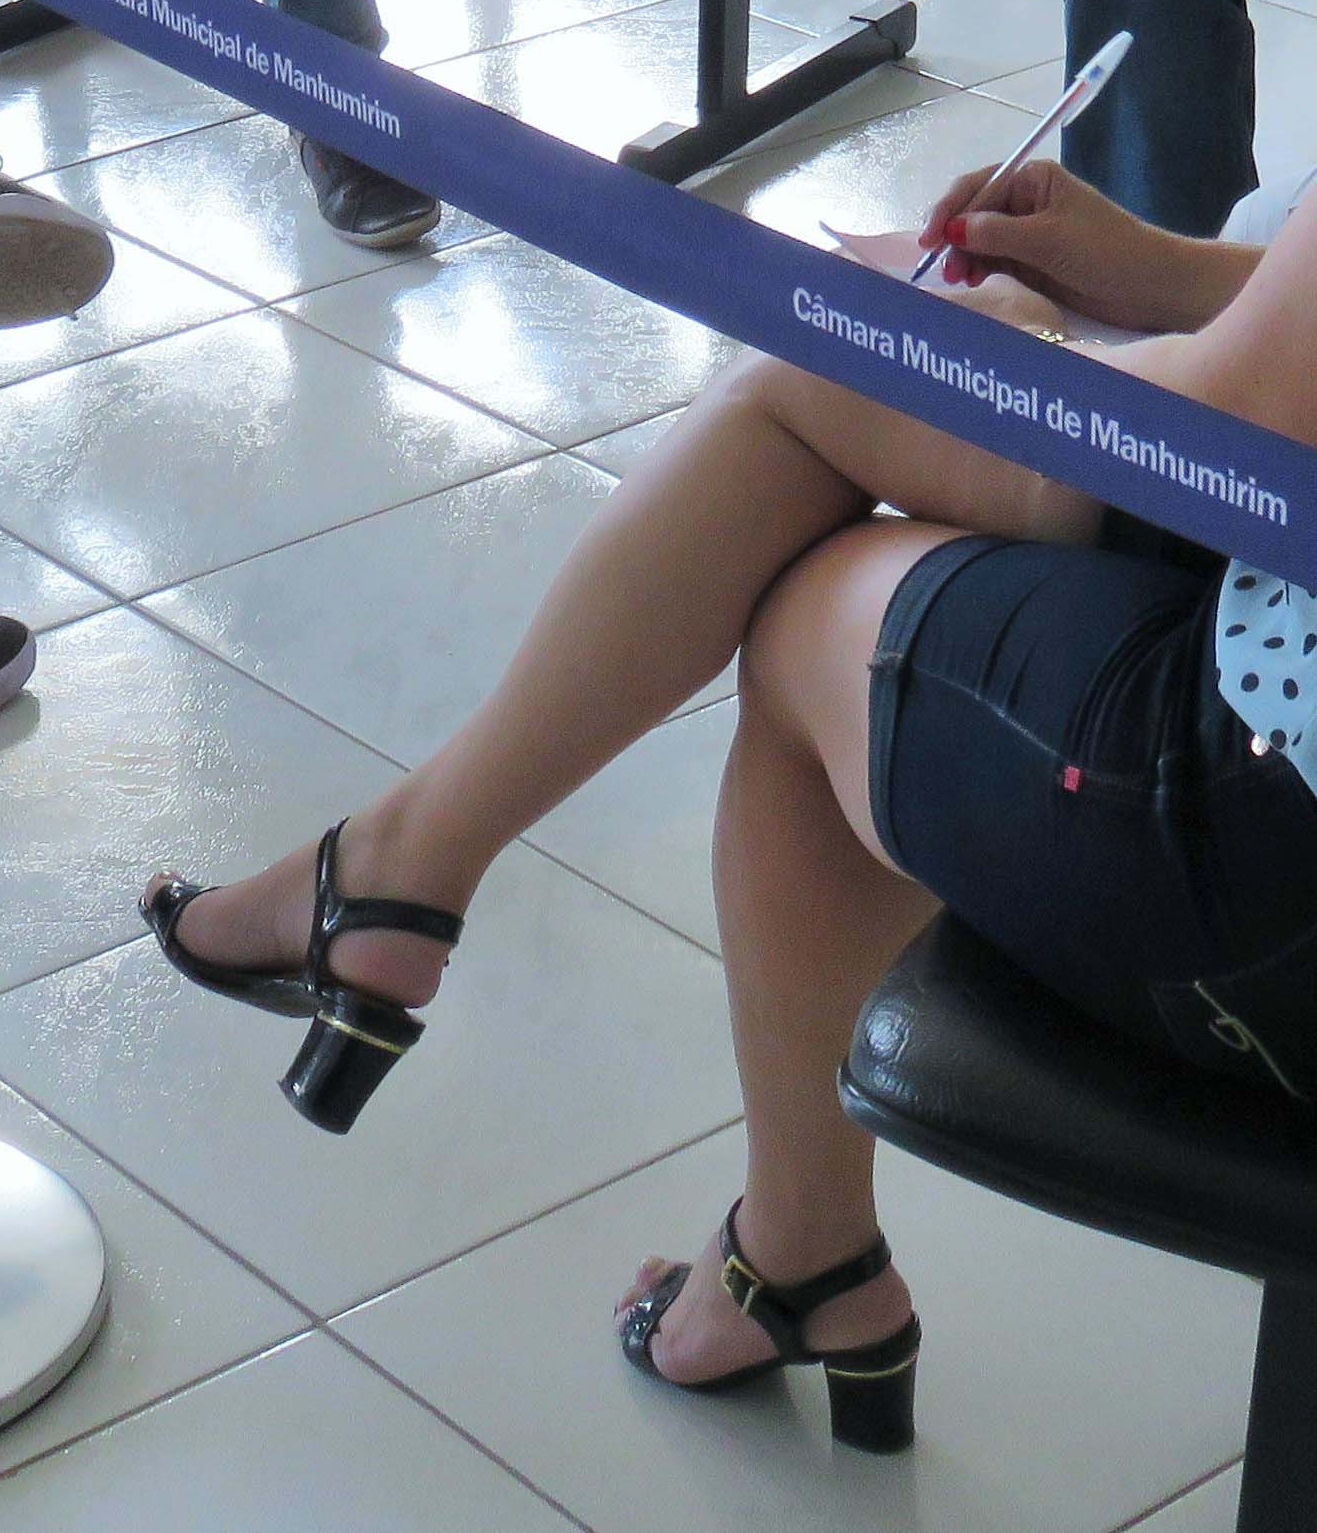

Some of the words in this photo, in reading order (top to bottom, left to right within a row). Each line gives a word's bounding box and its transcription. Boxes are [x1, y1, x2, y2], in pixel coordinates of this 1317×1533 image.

[246, 42, 269, 74] de
[274, 52, 400, 139] Manhumirim
[792, 287, 895, 360] Câmara
[902, 332, 1038, 421] Municipal
[1045, 398, 1082, 439] de
[1090, 411, 1288, 526] Manhumirim
